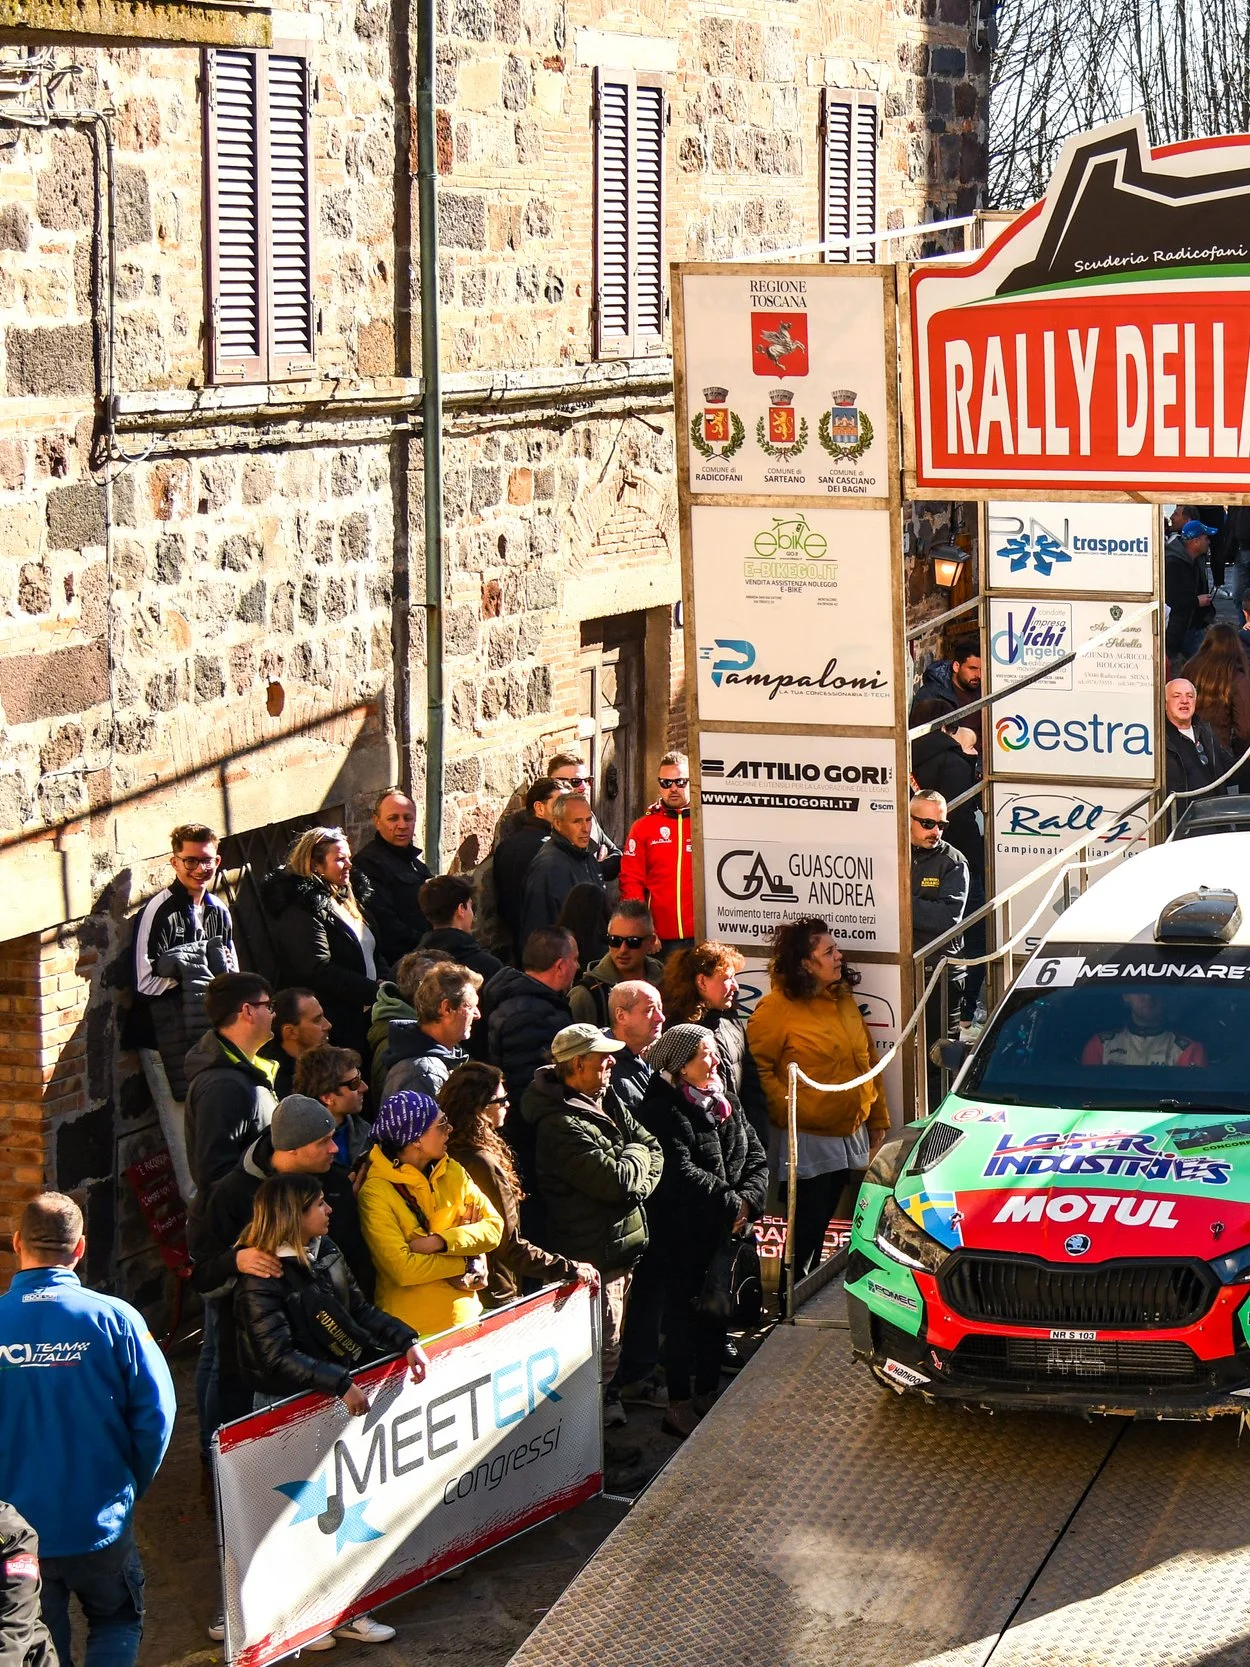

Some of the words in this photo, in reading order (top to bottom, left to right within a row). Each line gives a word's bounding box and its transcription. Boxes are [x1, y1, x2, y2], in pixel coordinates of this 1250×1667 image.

[1075, 253, 1149, 272] Scuderia
[1153, 245, 1247, 261] Radicofani
[750, 280, 807, 293] REGIONE
[750, 295, 807, 307] TOSCANA
[945, 328, 1100, 455] RALLY
[696, 474, 742, 482] RADICOFANI
[818, 476, 834, 484] SAN
[836, 477, 875, 485] CASCIANO
[1073, 536, 1148, 555] trasporti
[744, 562, 838, 579] E-BIKEGO.IT
[1031, 618, 1066, 628] impresa
[711, 639, 888, 700] Pampaloni
[1033, 713, 1152, 755] estra
[726, 761, 820, 781] ATTILIO
[824, 764, 889, 784] GORI
[702, 794, 853, 809] WWW.ATTILIOGORI.IT
[878, 803, 893, 811] scm
[789, 853, 874, 880] GUASCONI
[808, 881, 875, 907] ANDREA
[717, 907, 761, 918] Movimento
[762, 910, 781, 919] terra
[835, 914, 857, 923] conto
[859, 914, 876, 925] terzi
[1035, 959, 1061, 985] 6
[1077, 963, 1120, 977] MS
[1224, 1124, 1236, 1133] 6
[993, 1194, 1179, 1229] MOTUL
[875, 1284, 917, 1308] FOMEC
[1052, 1330, 1066, 1339] NR
[1069, 1331, 1075, 1339] S
[1078, 1331, 1095, 1340] 103
[36, 1342, 79, 1352] TEAM
[32, 1352, 81, 1361] ITALIA
[318, 1347, 563, 1522] MEETER
[443, 1419, 563, 1506] congressi
